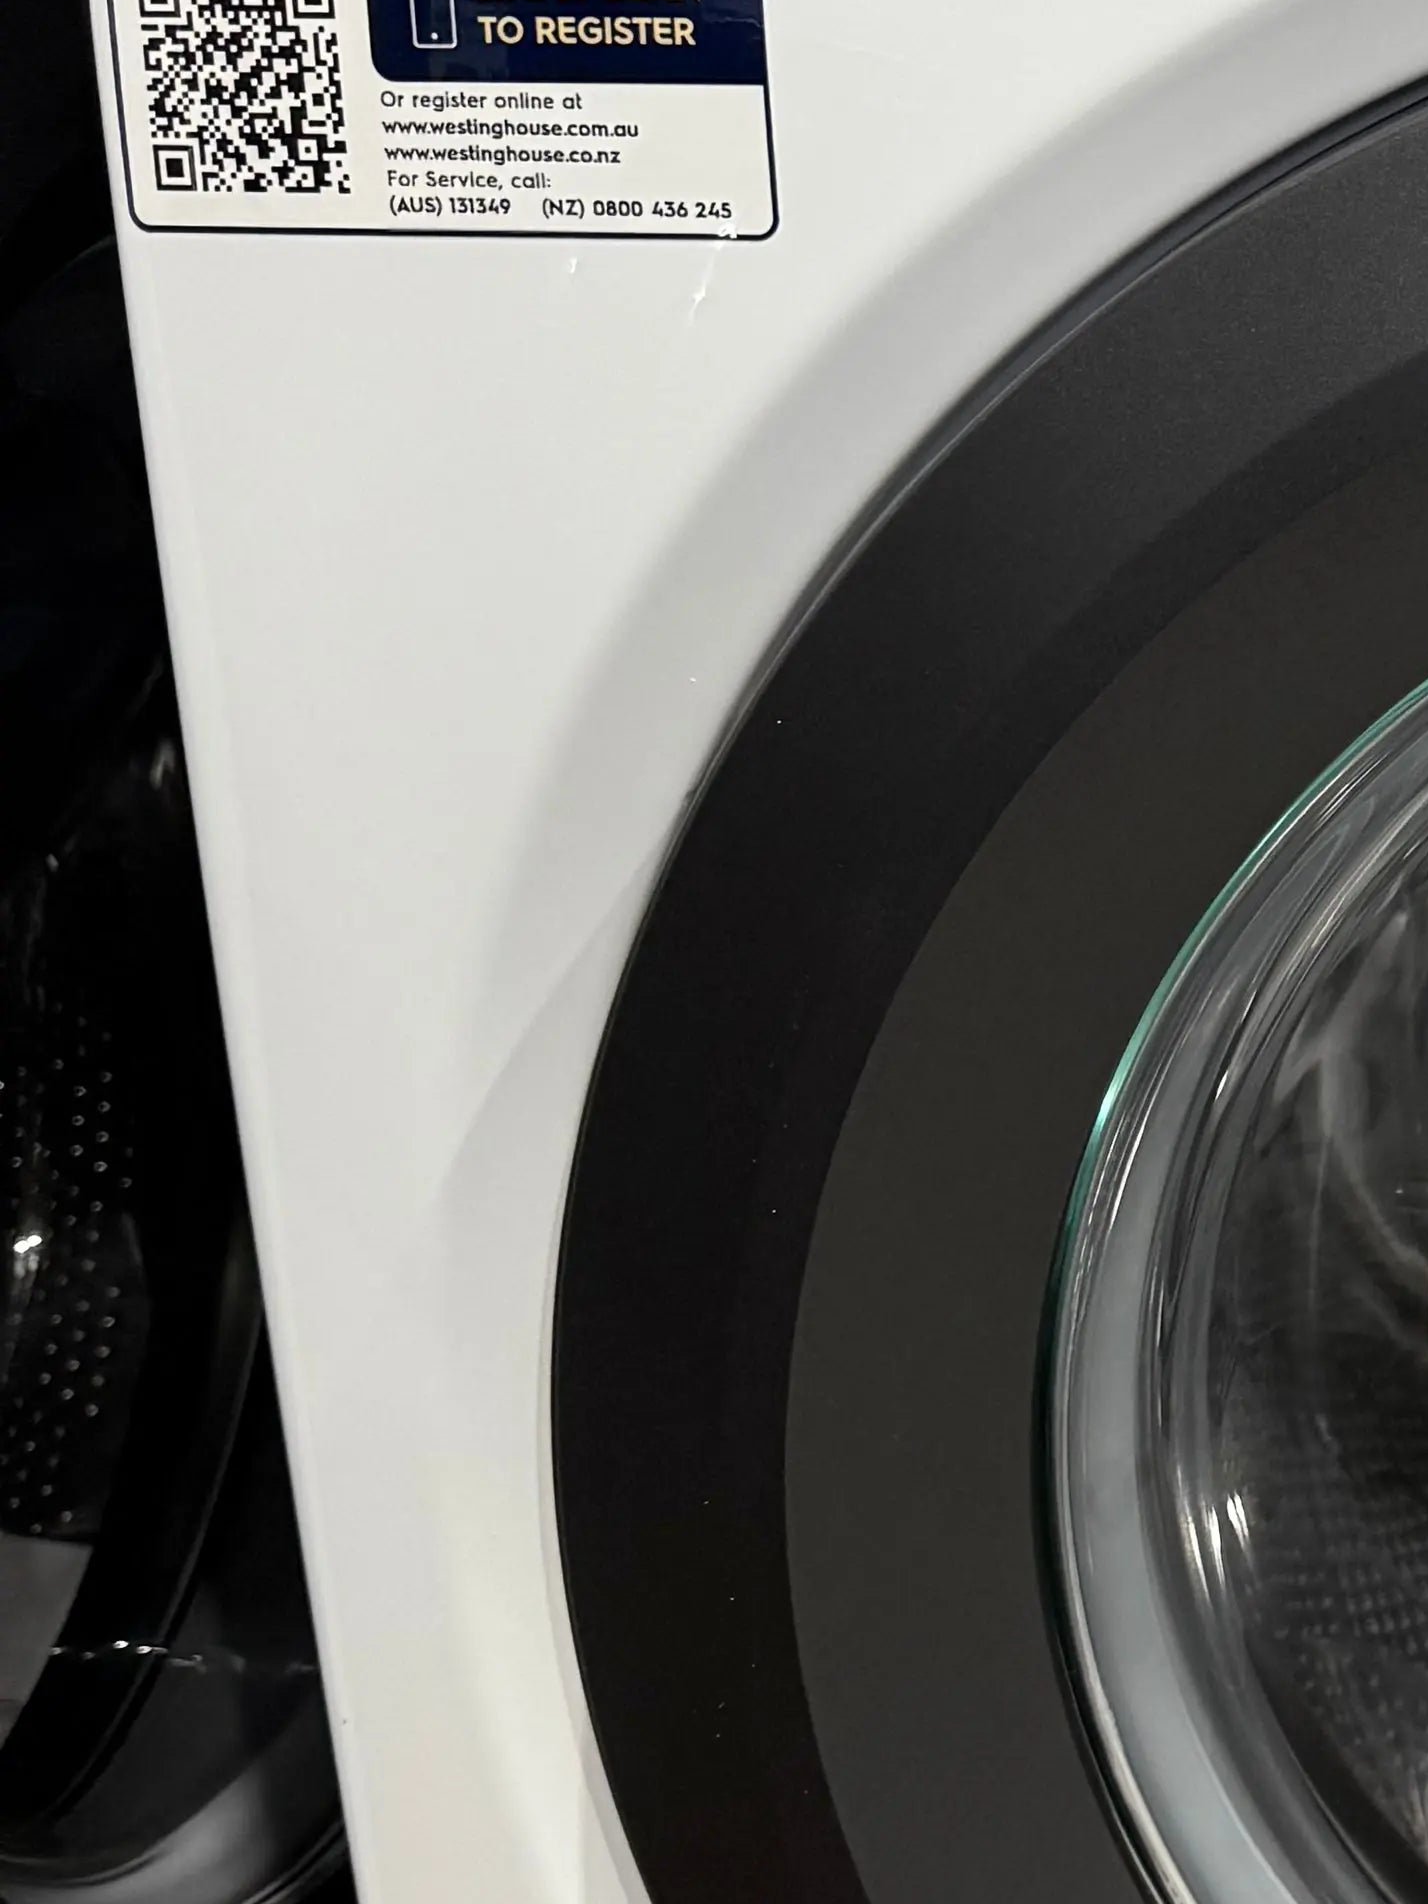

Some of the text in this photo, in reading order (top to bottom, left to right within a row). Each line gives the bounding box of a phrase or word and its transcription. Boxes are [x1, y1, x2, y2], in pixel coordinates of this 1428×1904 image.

[477, 15, 697, 46] TO REGISTER
[380, 90, 582, 112] Or register online at
[382, 119, 639, 140] www.westinghouse.com.au
[384, 146, 621, 166] www.westinghouse.co.nz
[387, 169, 552, 191] For Service, call:
[389, 195, 733, 219] (AUS) 131349 (NZ) 0800 436 245
